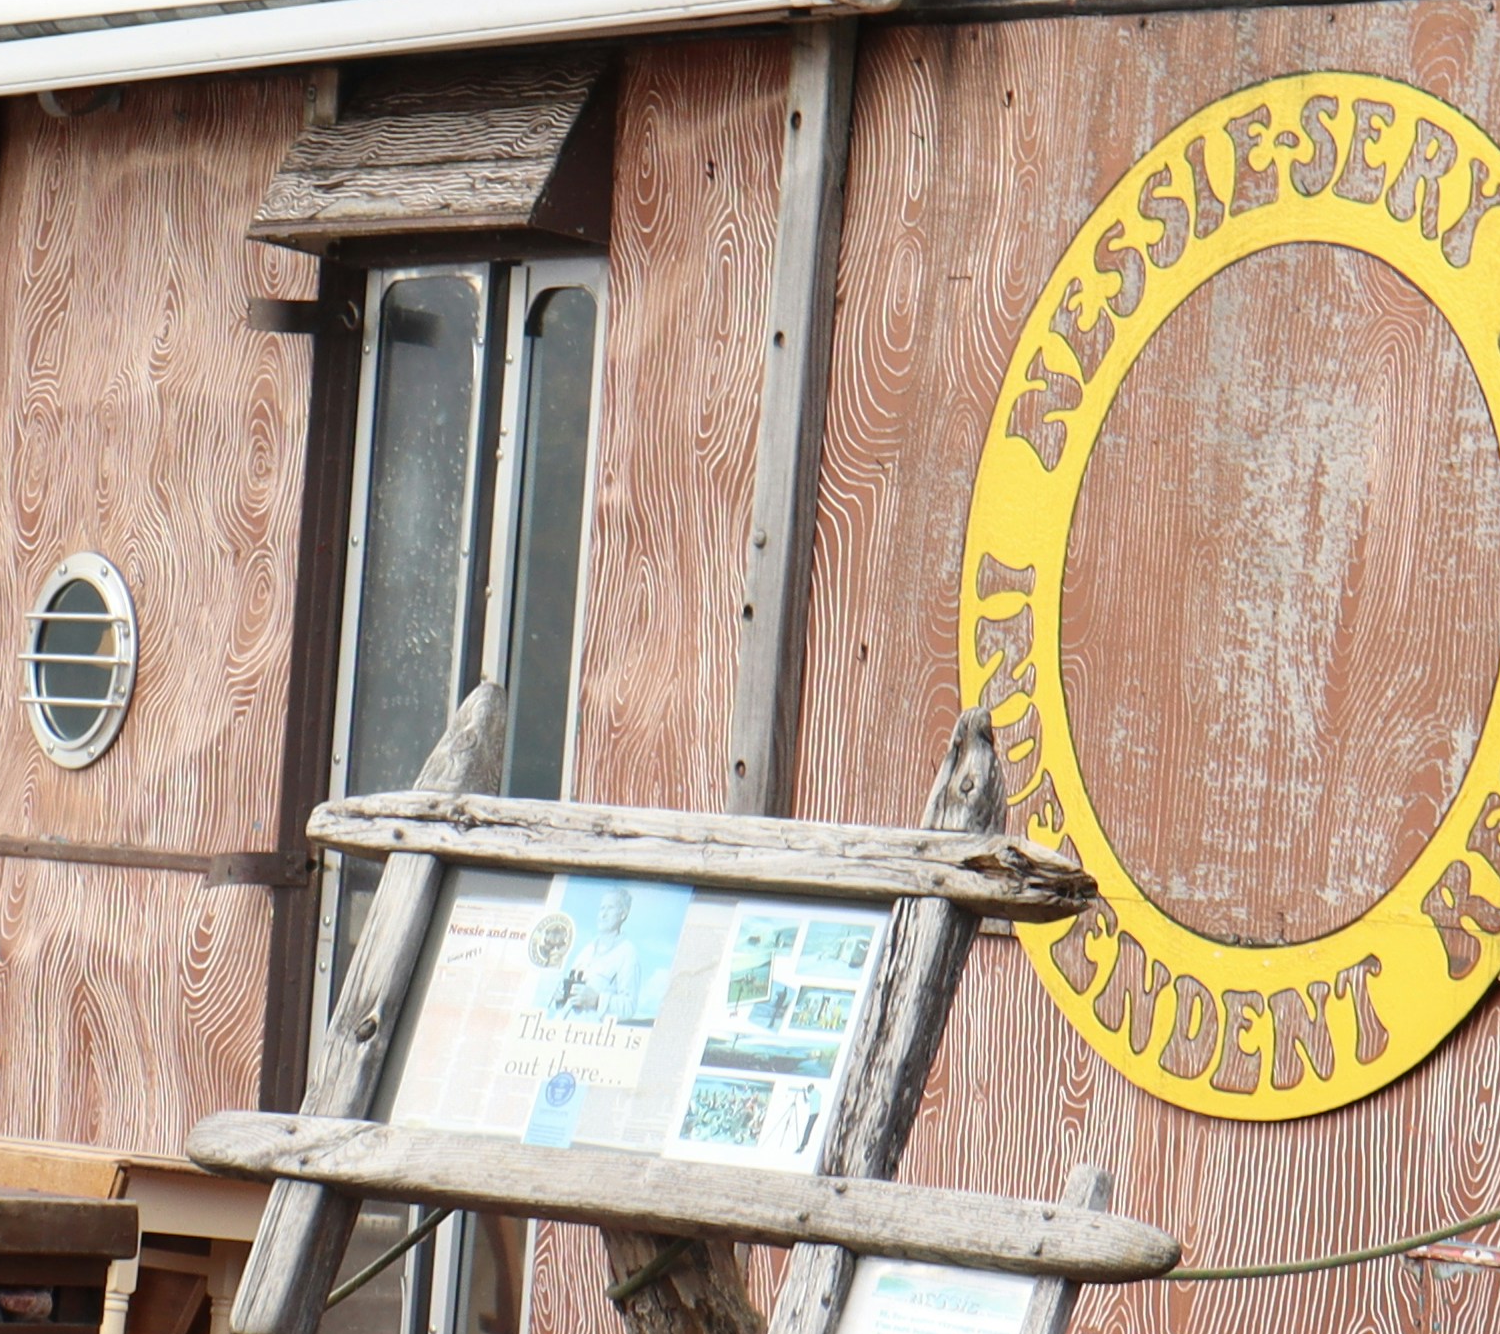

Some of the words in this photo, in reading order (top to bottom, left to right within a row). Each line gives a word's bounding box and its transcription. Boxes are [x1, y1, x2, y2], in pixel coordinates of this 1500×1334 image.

[975, 552, 1391, 1095] INDEENDENT
[448, 923, 485, 937] Nessie
[486, 927, 508, 940] and
[509, 930, 527, 941] me
[519, 1011, 557, 1042] The
[565, 1018, 616, 1047] truth
[625, 1028, 643, 1050] is
[504, 1056, 540, 1076] out
